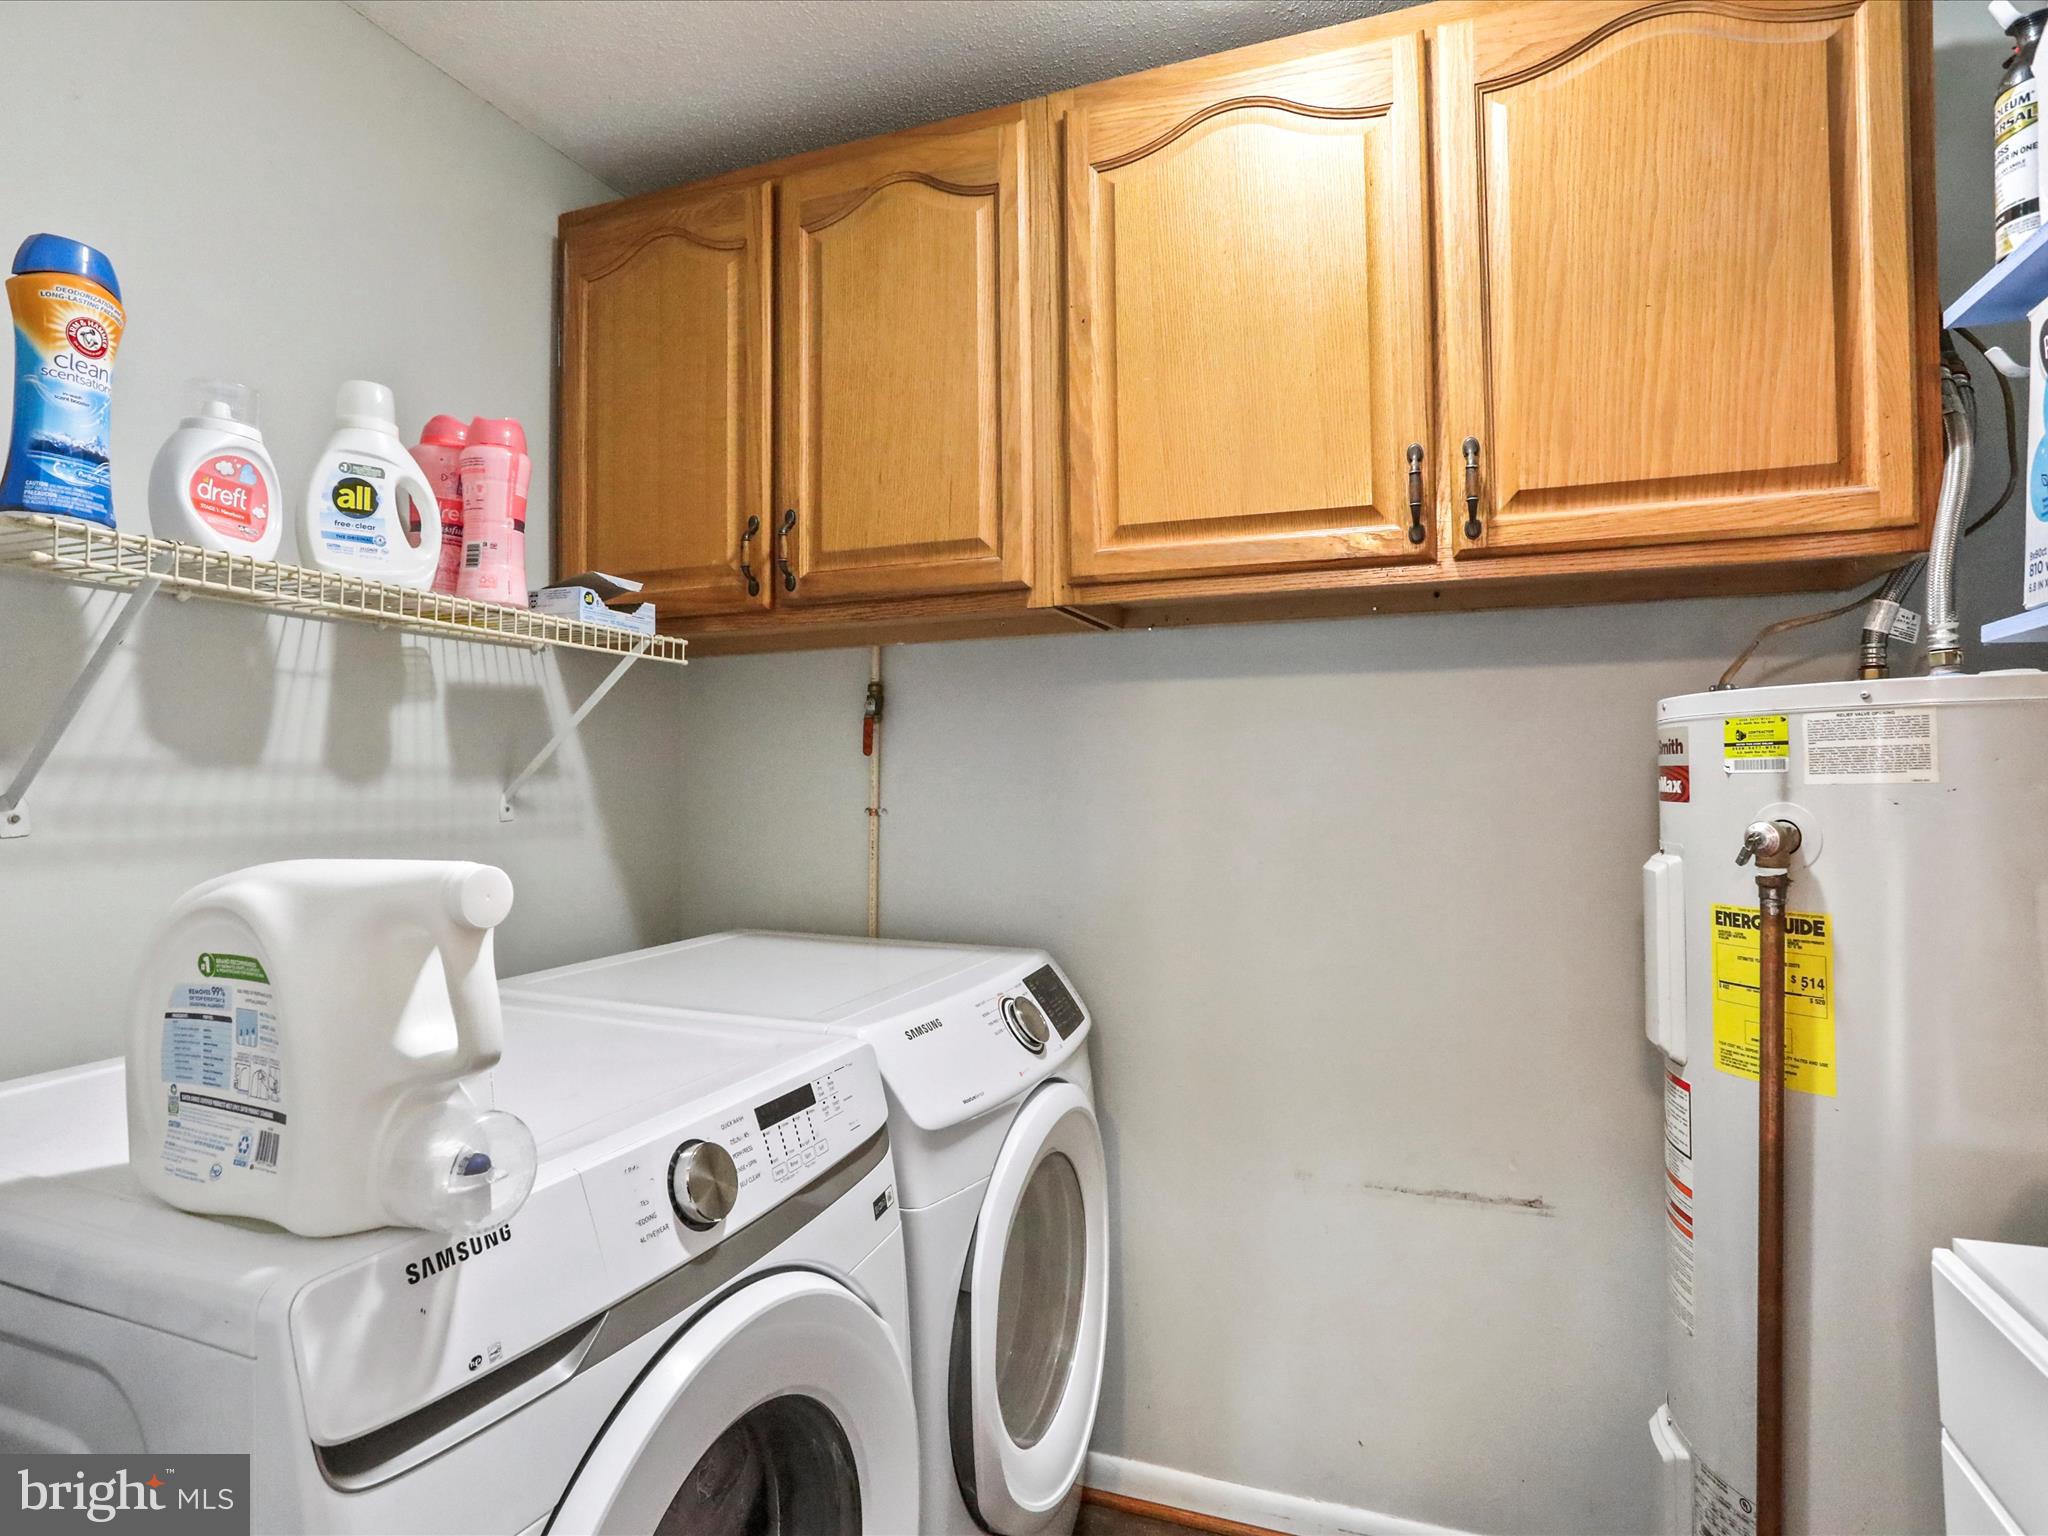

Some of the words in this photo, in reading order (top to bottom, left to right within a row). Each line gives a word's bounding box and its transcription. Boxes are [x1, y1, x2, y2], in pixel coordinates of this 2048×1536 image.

[1996, 92, 2032, 119] OLEUM
[1996, 108, 2034, 136] ERSAL
[2020, 141, 2039, 154] ONE
[69, 321, 80, 337] ARM
[40, 366, 112, 393] scentsation
[53, 353, 109, 383] clean
[197, 477, 248, 512] dreft
[337, 485, 371, 512] all
[334, 519, 352, 529] free
[354, 521, 377, 532] clear
[1801, 977, 1825, 990] 514
[904, 1017, 944, 1041] SAMSUNG
[405, 1223, 513, 1286] SAMSUNG
